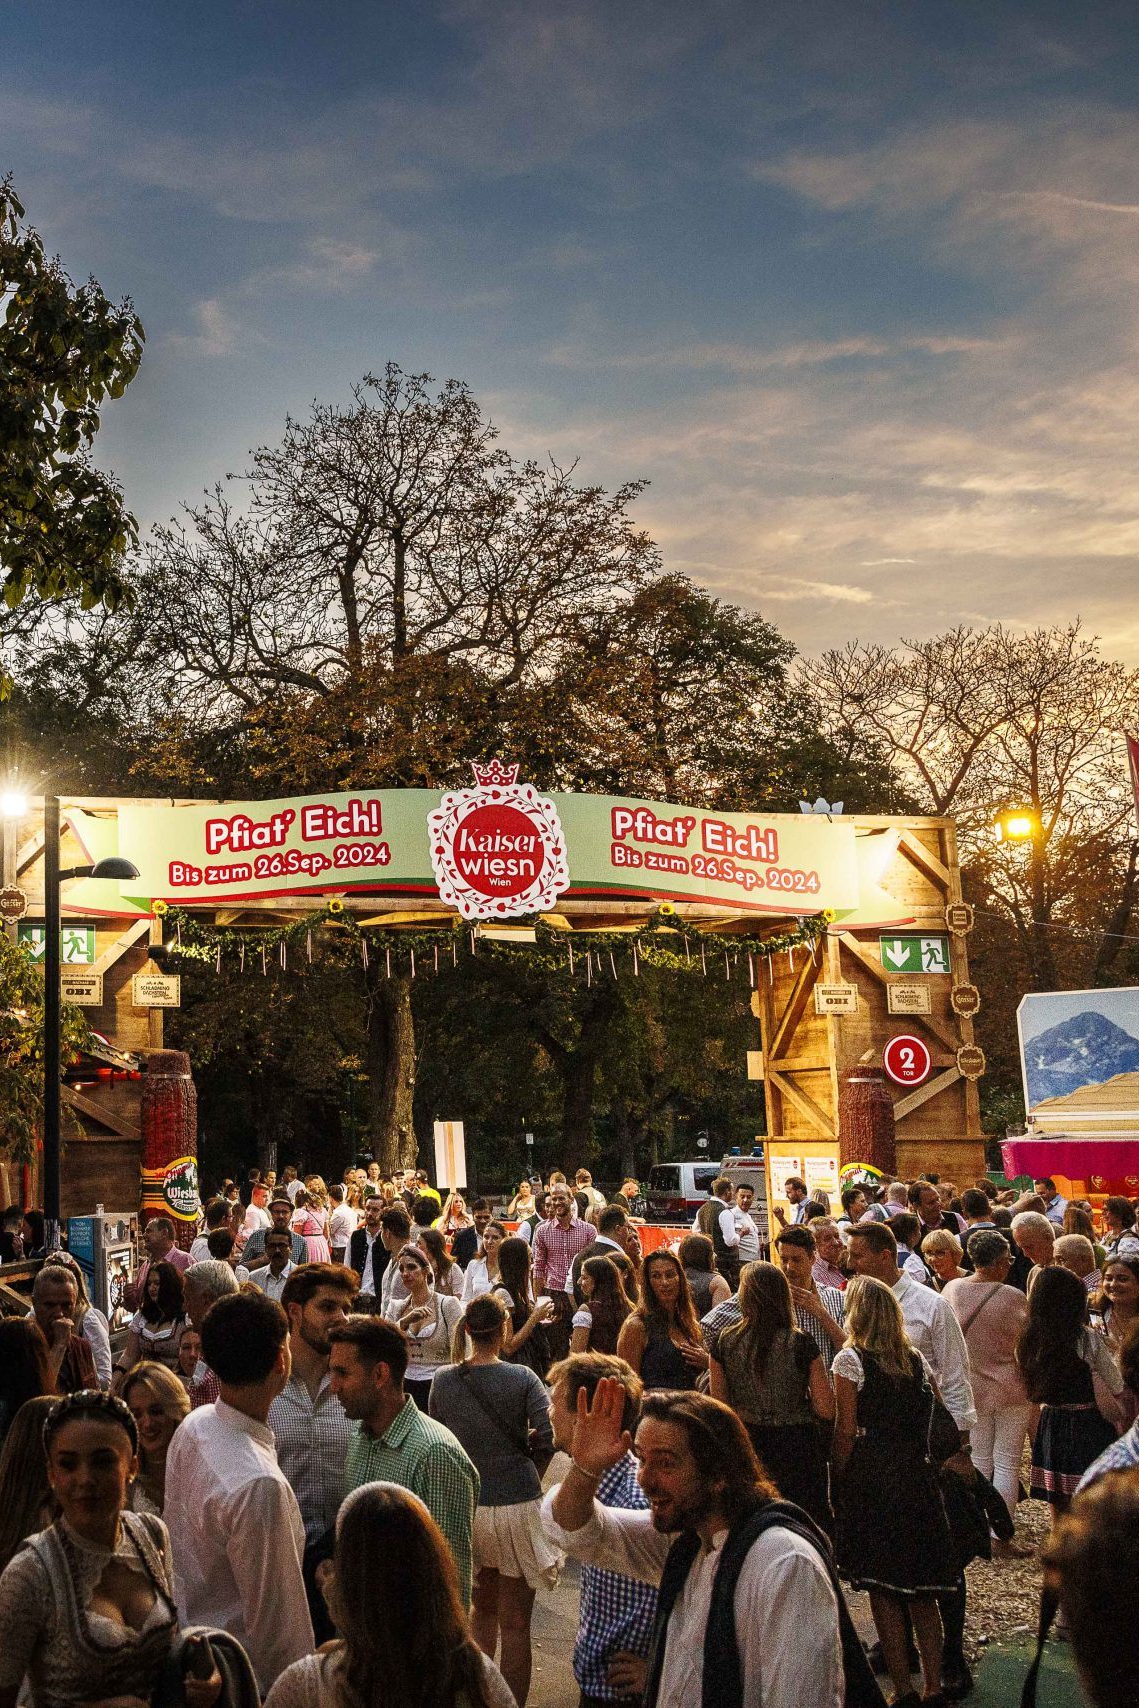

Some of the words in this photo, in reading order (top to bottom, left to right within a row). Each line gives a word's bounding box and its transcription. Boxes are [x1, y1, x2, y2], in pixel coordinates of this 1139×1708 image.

[304, 802, 380, 839] Eich!
[457, 829, 543, 853] Kaiser
[704, 821, 776, 861] Eich!
[171, 864, 200, 884] Bis
[207, 865, 250, 883] zum
[256, 852, 331, 876] 26.Sep.
[335, 845, 389, 866] 2024
[459, 853, 536, 877] wiesn
[614, 846, 640, 866] Bis
[646, 854, 687, 872] zum
[693, 857, 763, 888] 26.Sep.
[768, 870, 818, 891] 2024
[488, 877, 512, 887] Wien
[65, 988, 92, 996] OBI
[825, 997, 849, 1005] OBI
[899, 1047, 916, 1069] 2
